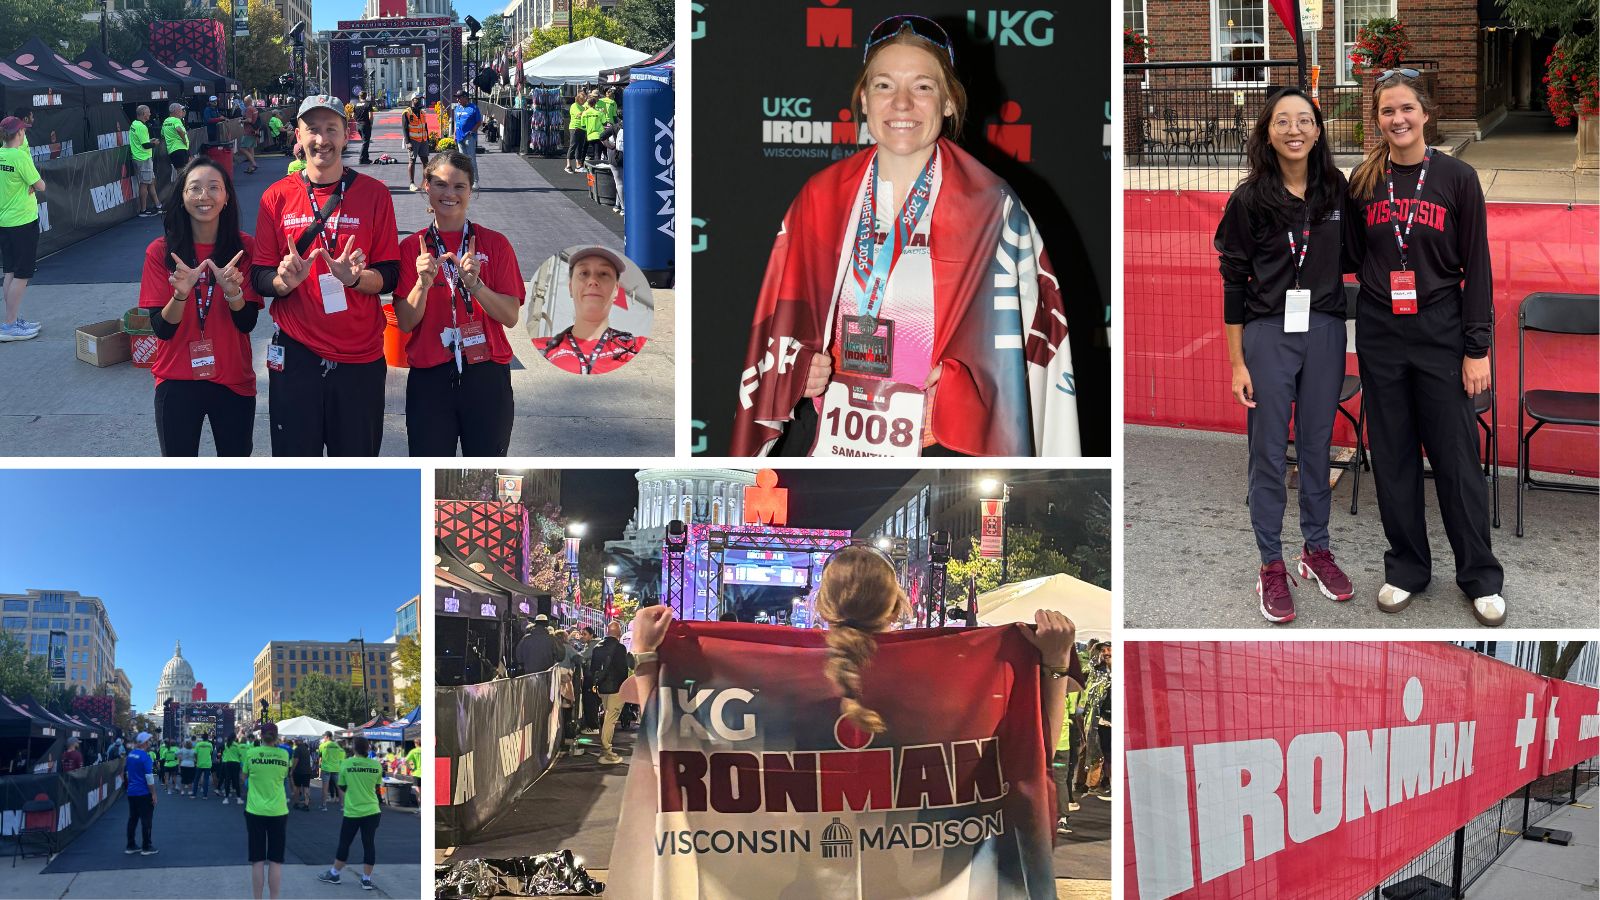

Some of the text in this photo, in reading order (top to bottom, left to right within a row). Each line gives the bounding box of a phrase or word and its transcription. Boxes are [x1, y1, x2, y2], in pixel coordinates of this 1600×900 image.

[966, 9, 1055, 47] UKG
[763, 97, 812, 117] UKG
[763, 148, 829, 158] WISCONSIN
[655, 116, 675, 239] AMACX
[861, 164, 874, 226] TEMBER
[903, 198, 921, 226] 2026
[858, 244, 869, 271] 2026
[845, 342, 860, 351] UKG
[845, 349, 888, 363] IRONMAN
[826, 406, 914, 448] 1008
[832, 445, 895, 457] SAMANT
[746, 549, 784, 561] IRONMAN
[251, 757, 288, 767] VOLUNTEER
[346, 766, 380, 774] VOLUNTEER
[659, 713, 1004, 813] RONMAN
[1125, 676, 1476, 900] IRONMAN
[859, 809, 1004, 851] MADISON
